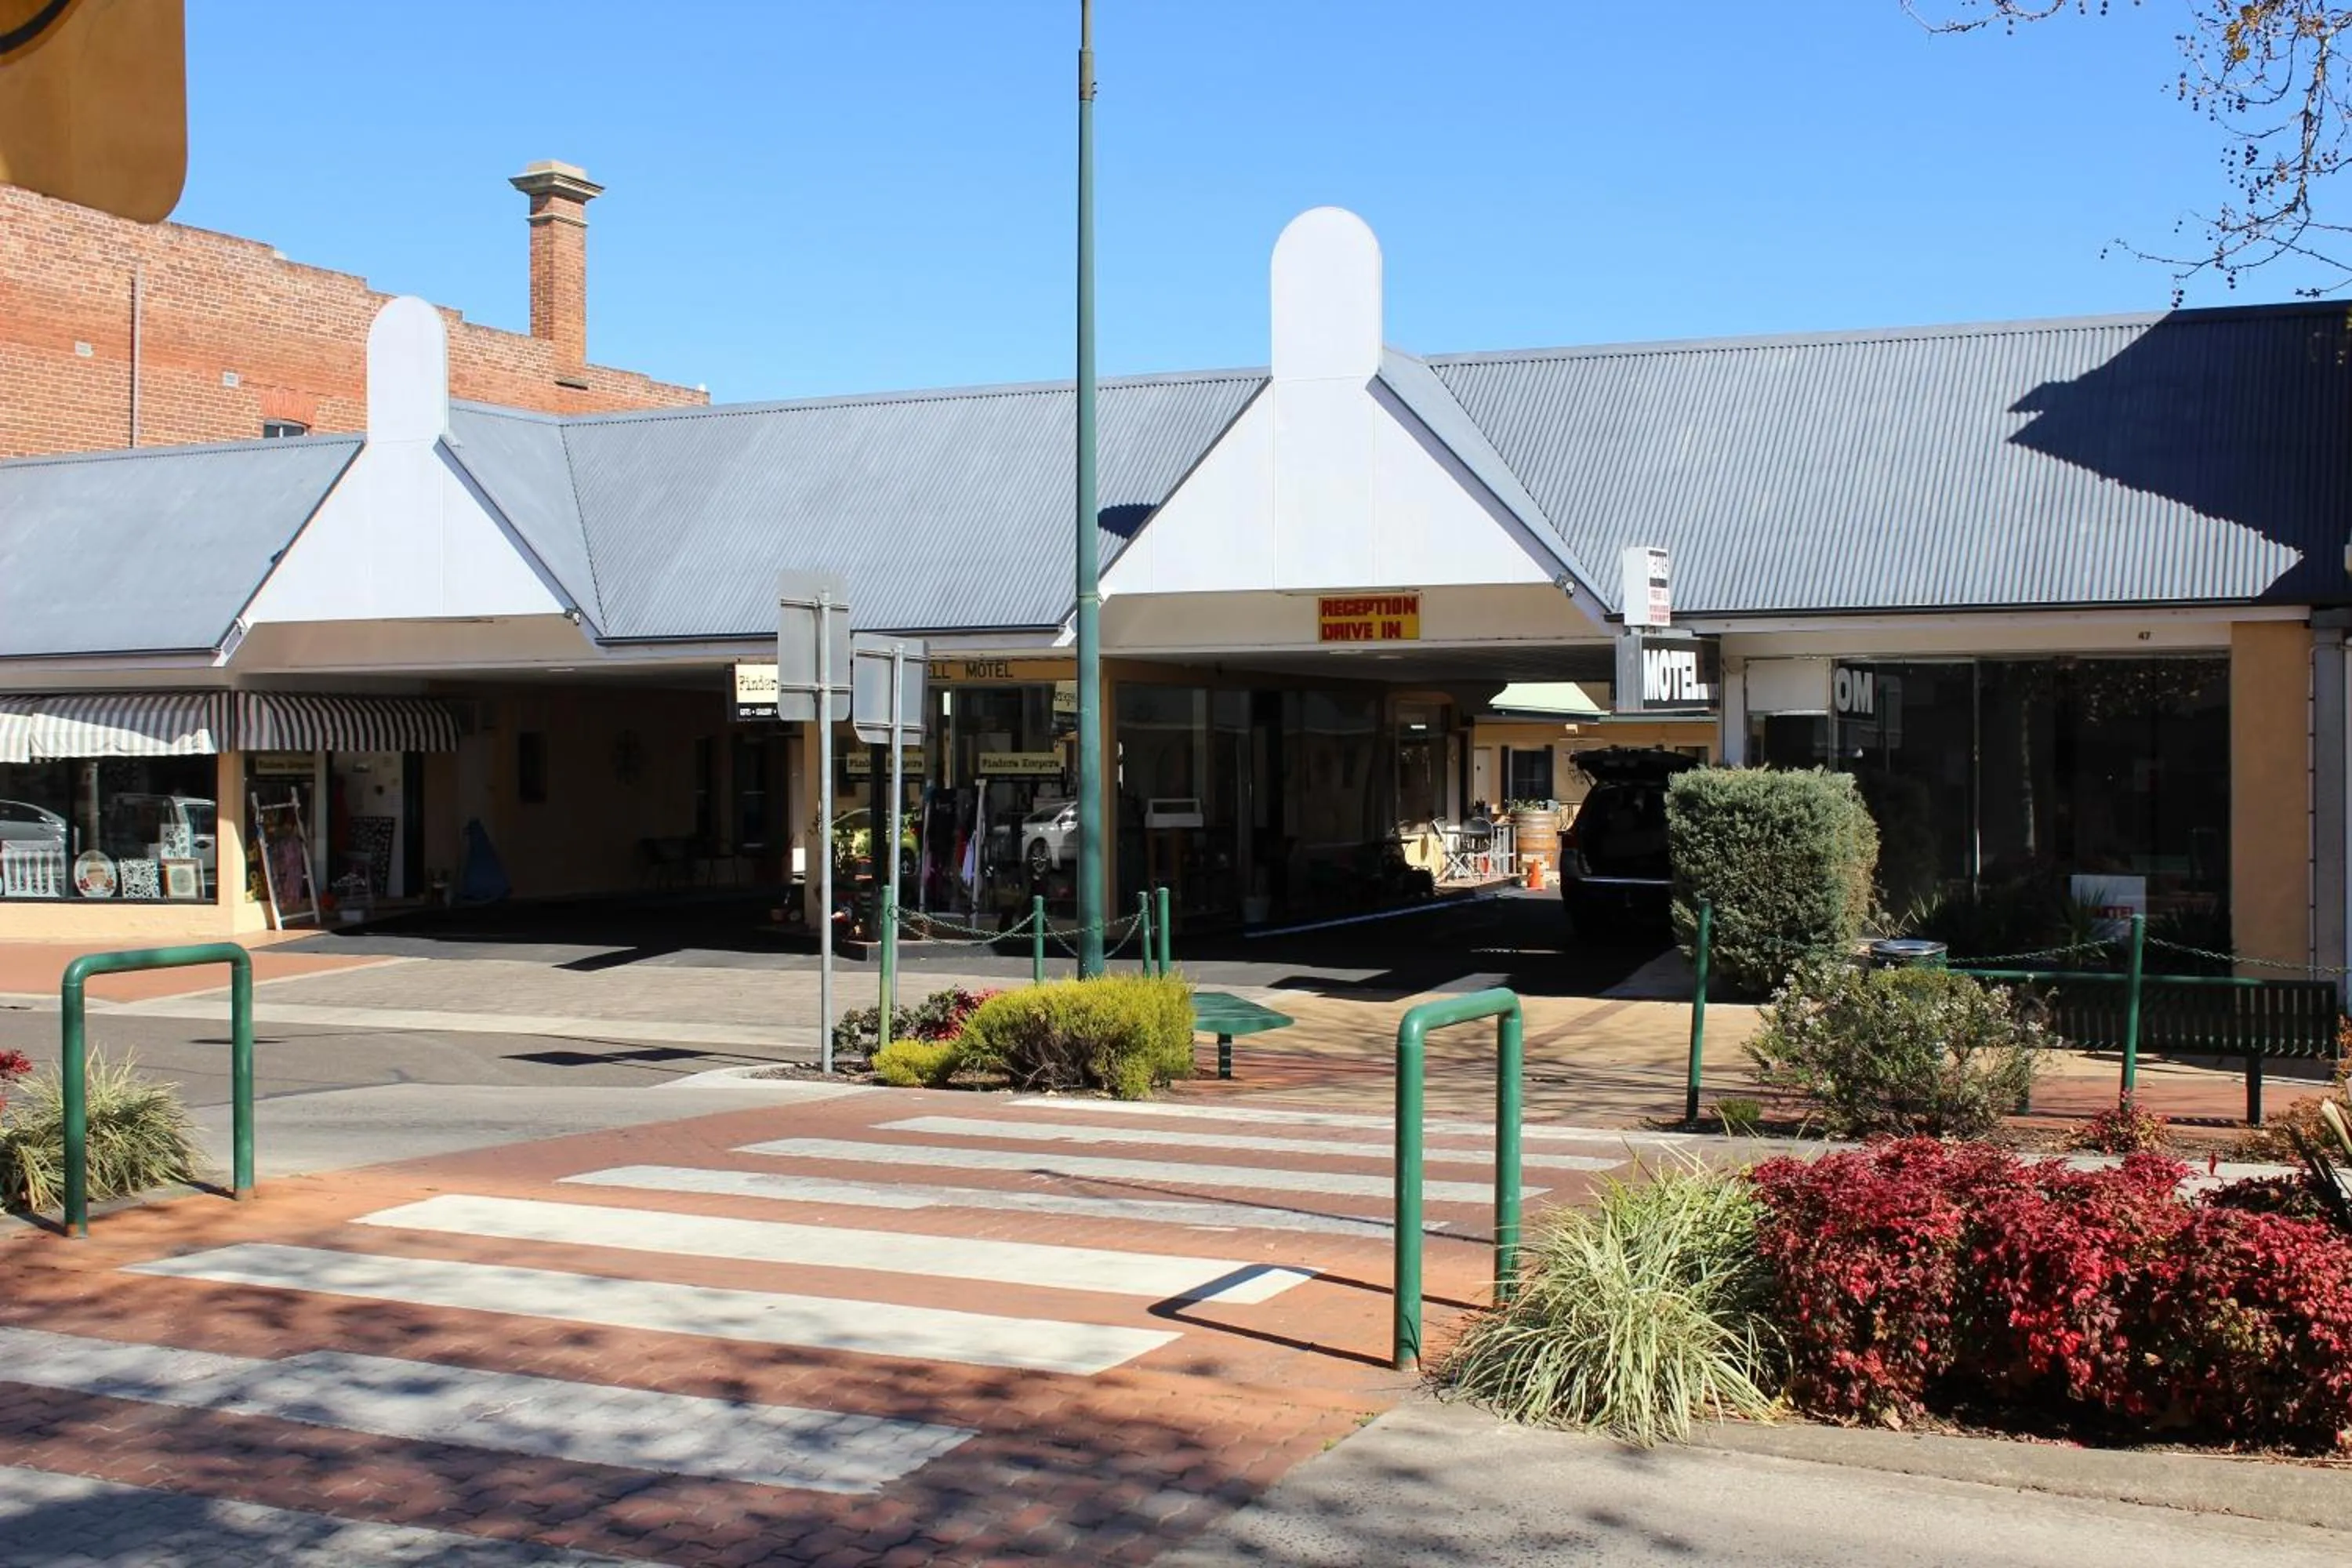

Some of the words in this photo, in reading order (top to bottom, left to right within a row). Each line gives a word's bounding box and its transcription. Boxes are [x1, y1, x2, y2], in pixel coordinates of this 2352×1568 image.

[1321, 597, 1417, 616] RECEPTION
[1321, 622, 1374, 641] DRIVE
[1381, 620, 1402, 640] IN
[2138, 630, 2151, 641] 47
[964, 660, 1014, 680] MOTEL
[1642, 648, 1709, 702] MOTEL
